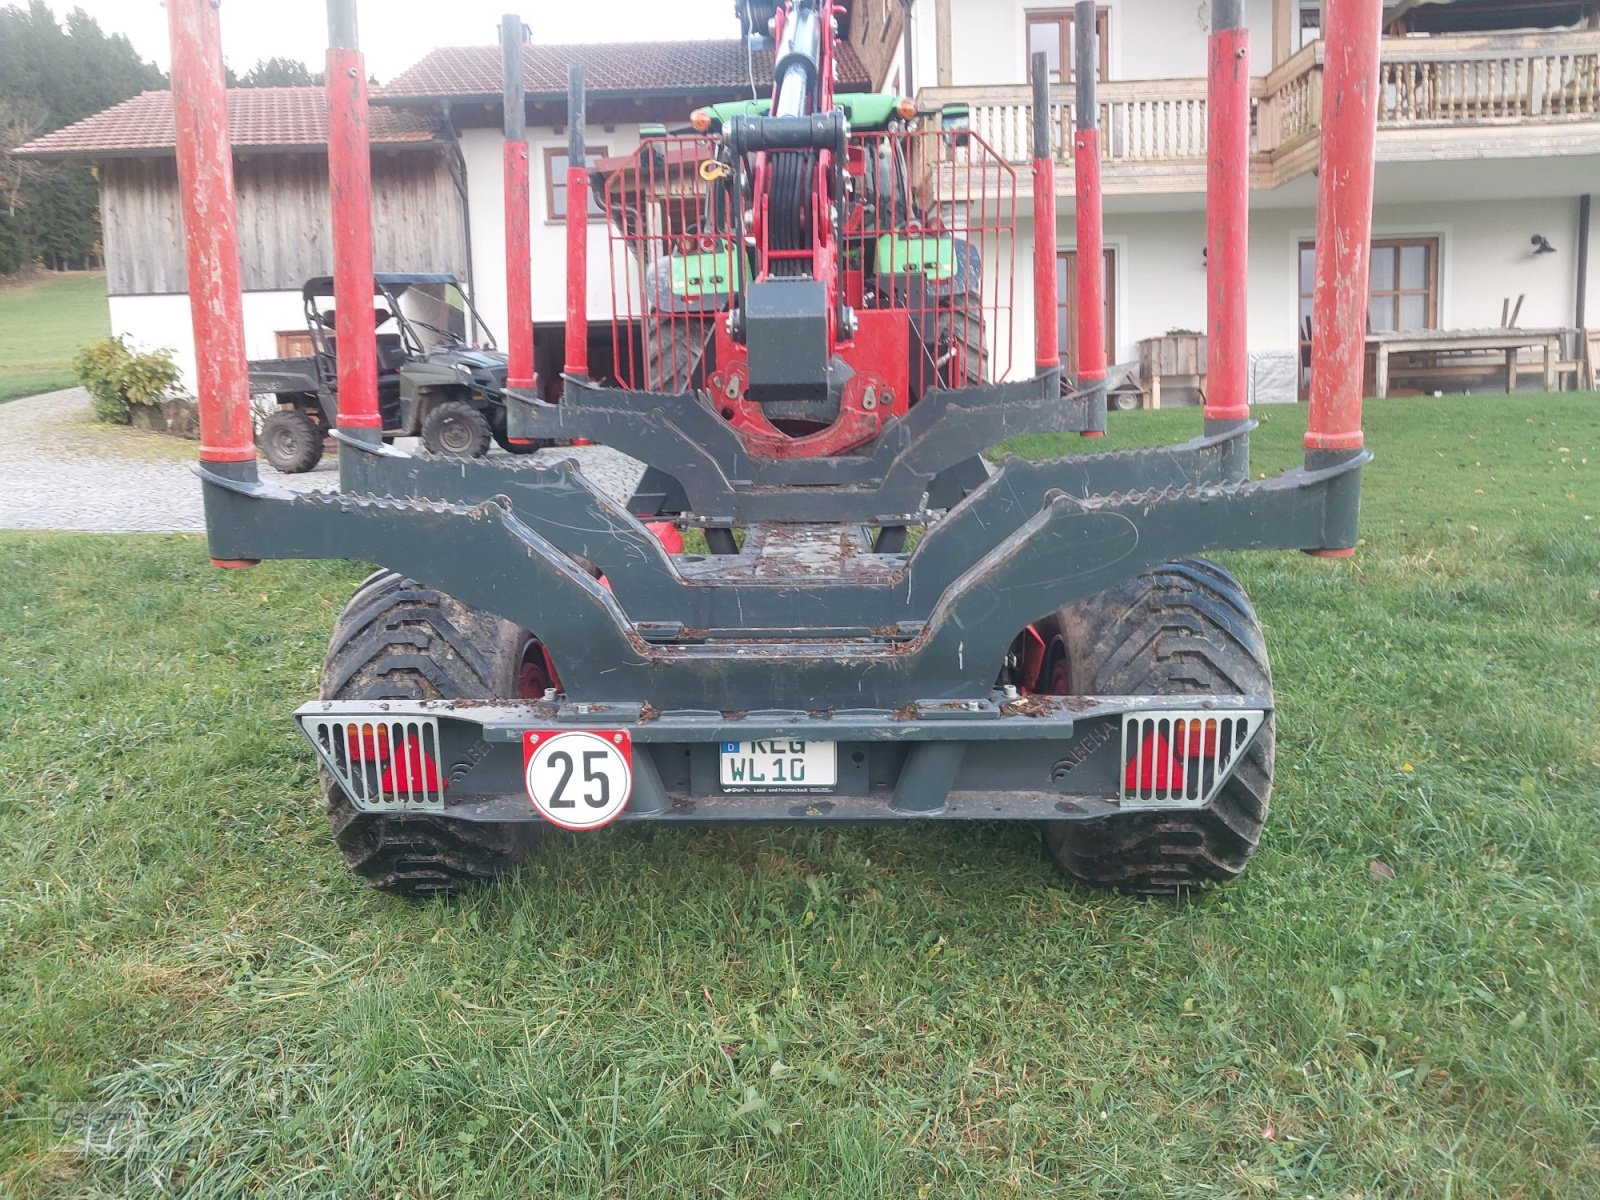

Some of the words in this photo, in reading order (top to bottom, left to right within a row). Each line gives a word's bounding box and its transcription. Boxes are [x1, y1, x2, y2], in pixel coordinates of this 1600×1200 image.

[727, 743, 735, 752] D
[547, 750, 610, 809] 25
[730, 758, 765, 782] WL
[772, 758, 805, 782] 10
